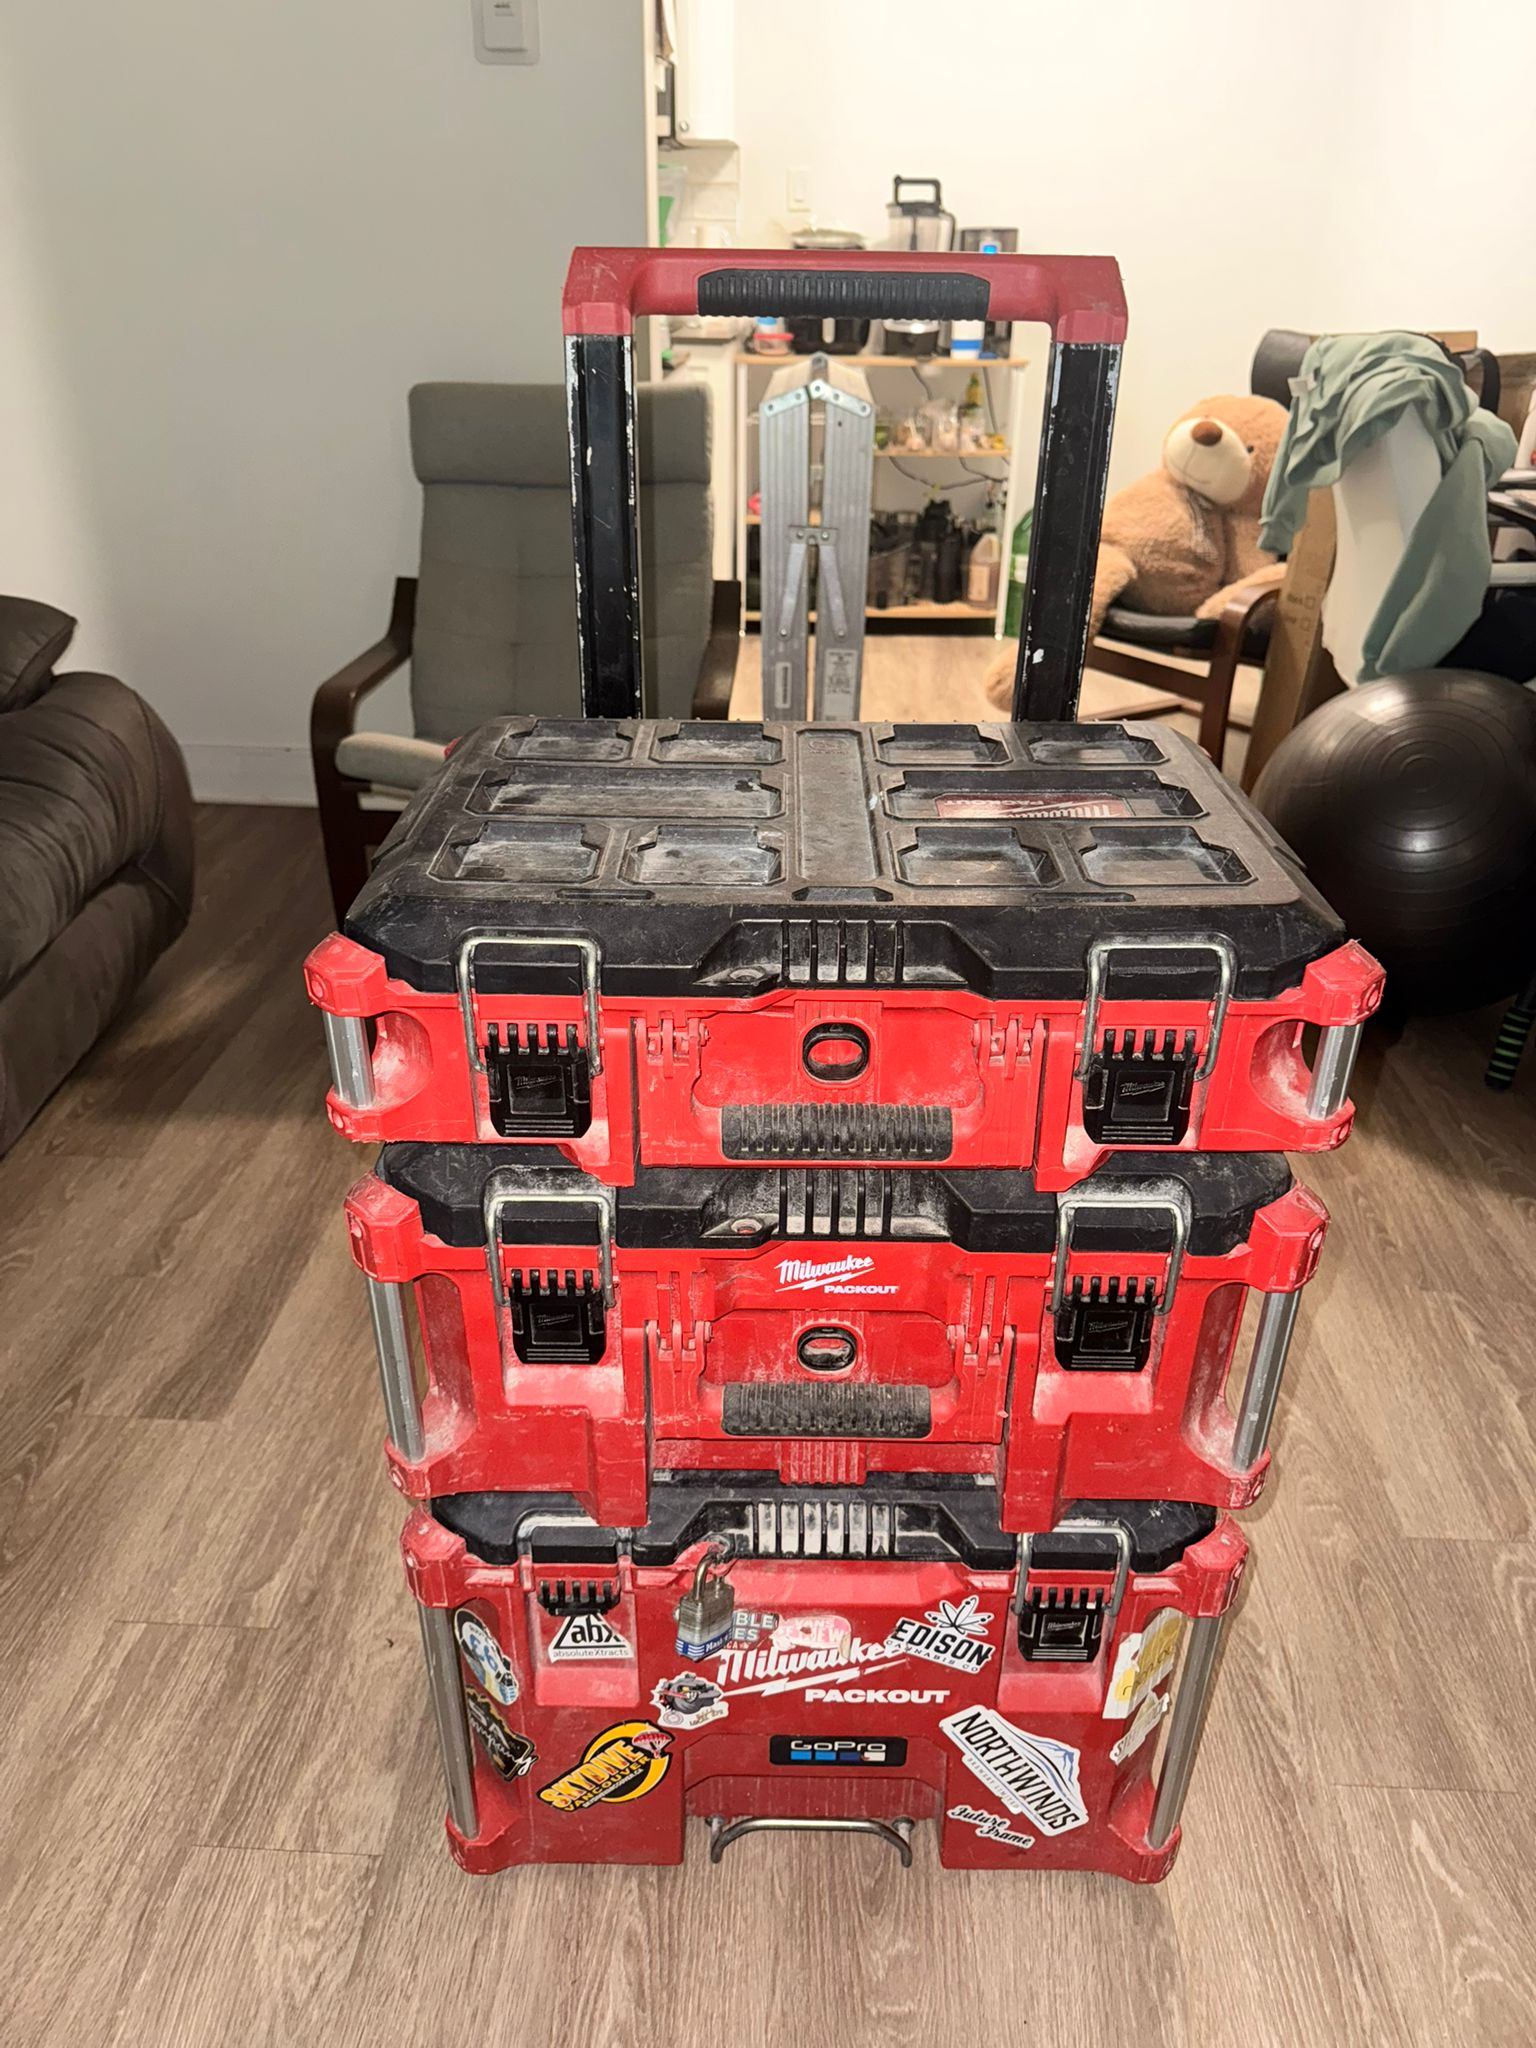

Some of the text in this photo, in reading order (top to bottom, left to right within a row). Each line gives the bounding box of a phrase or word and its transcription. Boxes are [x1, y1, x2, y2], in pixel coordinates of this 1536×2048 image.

[774, 1255, 875, 1284] Milwaukee
[824, 1285, 899, 1294] PACKOUT
[736, 1612, 774, 1629] BLE
[734, 1628, 758, 1641] ES
[891, 1620, 994, 1666] EDISON
[704, 1638, 906, 1686] Milwaukee
[886, 1640, 979, 1673] CANNABIS CO
[805, 1689, 950, 1704] PACKOUT
[791, 1740, 886, 1751] GoPro
[540, 1740, 644, 1809] SKYDIVE
[952, 1711, 1080, 1830] NORTHWINDS
[564, 1756, 650, 1812] VANCOUVER
[951, 1806, 1007, 1828] Future
[980, 1826, 1032, 1847] Frame
